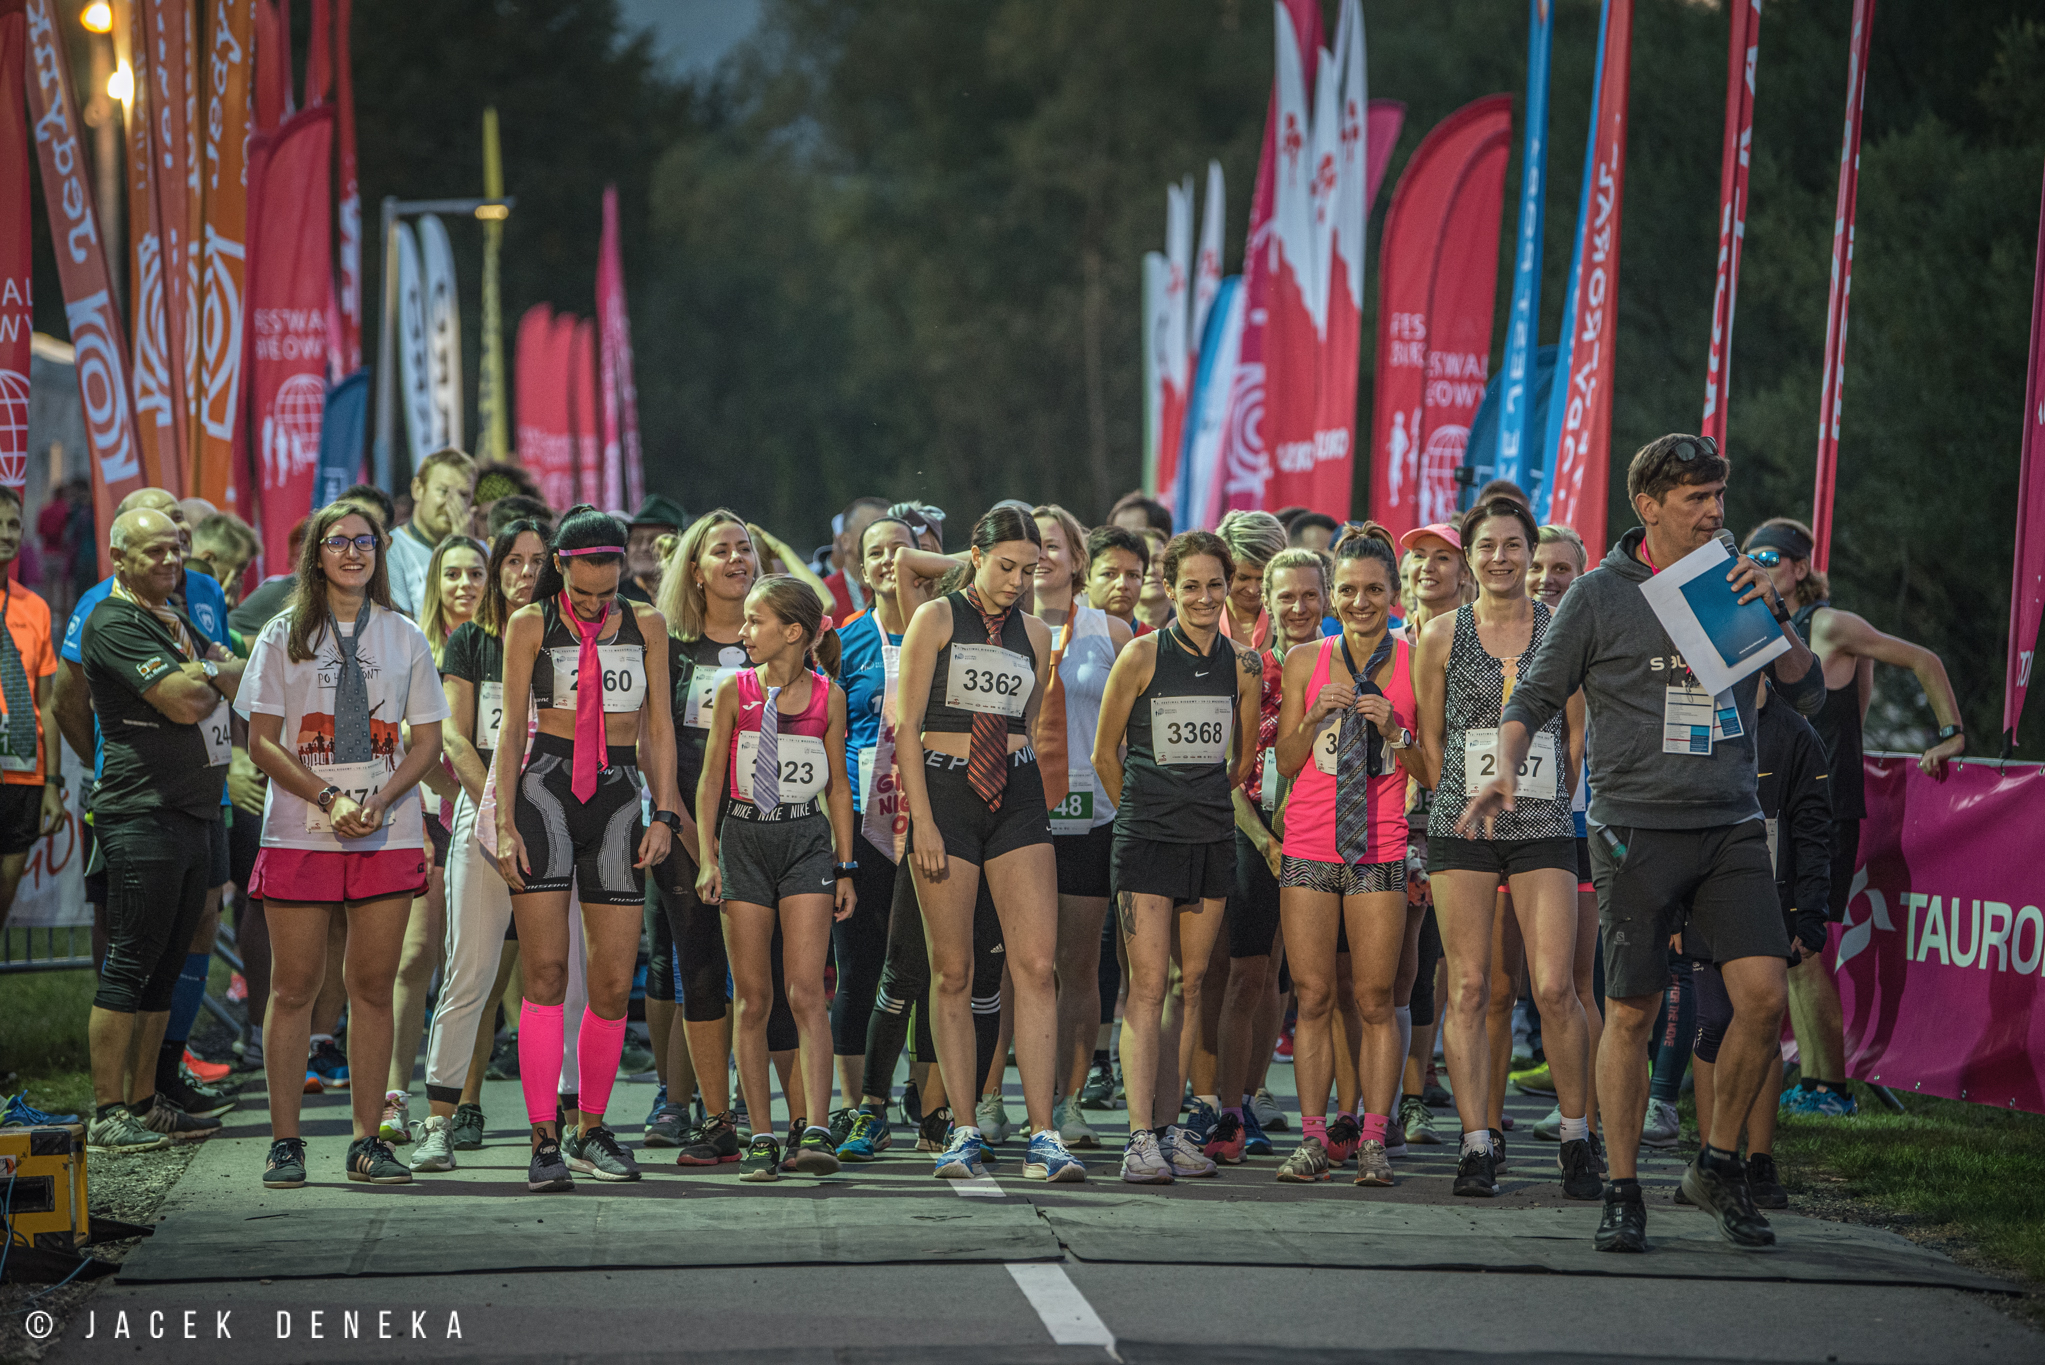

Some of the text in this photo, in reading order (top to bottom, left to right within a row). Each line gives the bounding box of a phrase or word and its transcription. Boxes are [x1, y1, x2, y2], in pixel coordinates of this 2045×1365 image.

[570, 669, 632, 692] 260
[963, 668, 1023, 697] 3362
[1167, 722, 1223, 745] 3368
[1480, 753, 1543, 778] 267
[731, 803, 754, 819] NIKE
[790, 802, 811, 819] NIKE
[1900, 891, 2045, 978] TAURO
